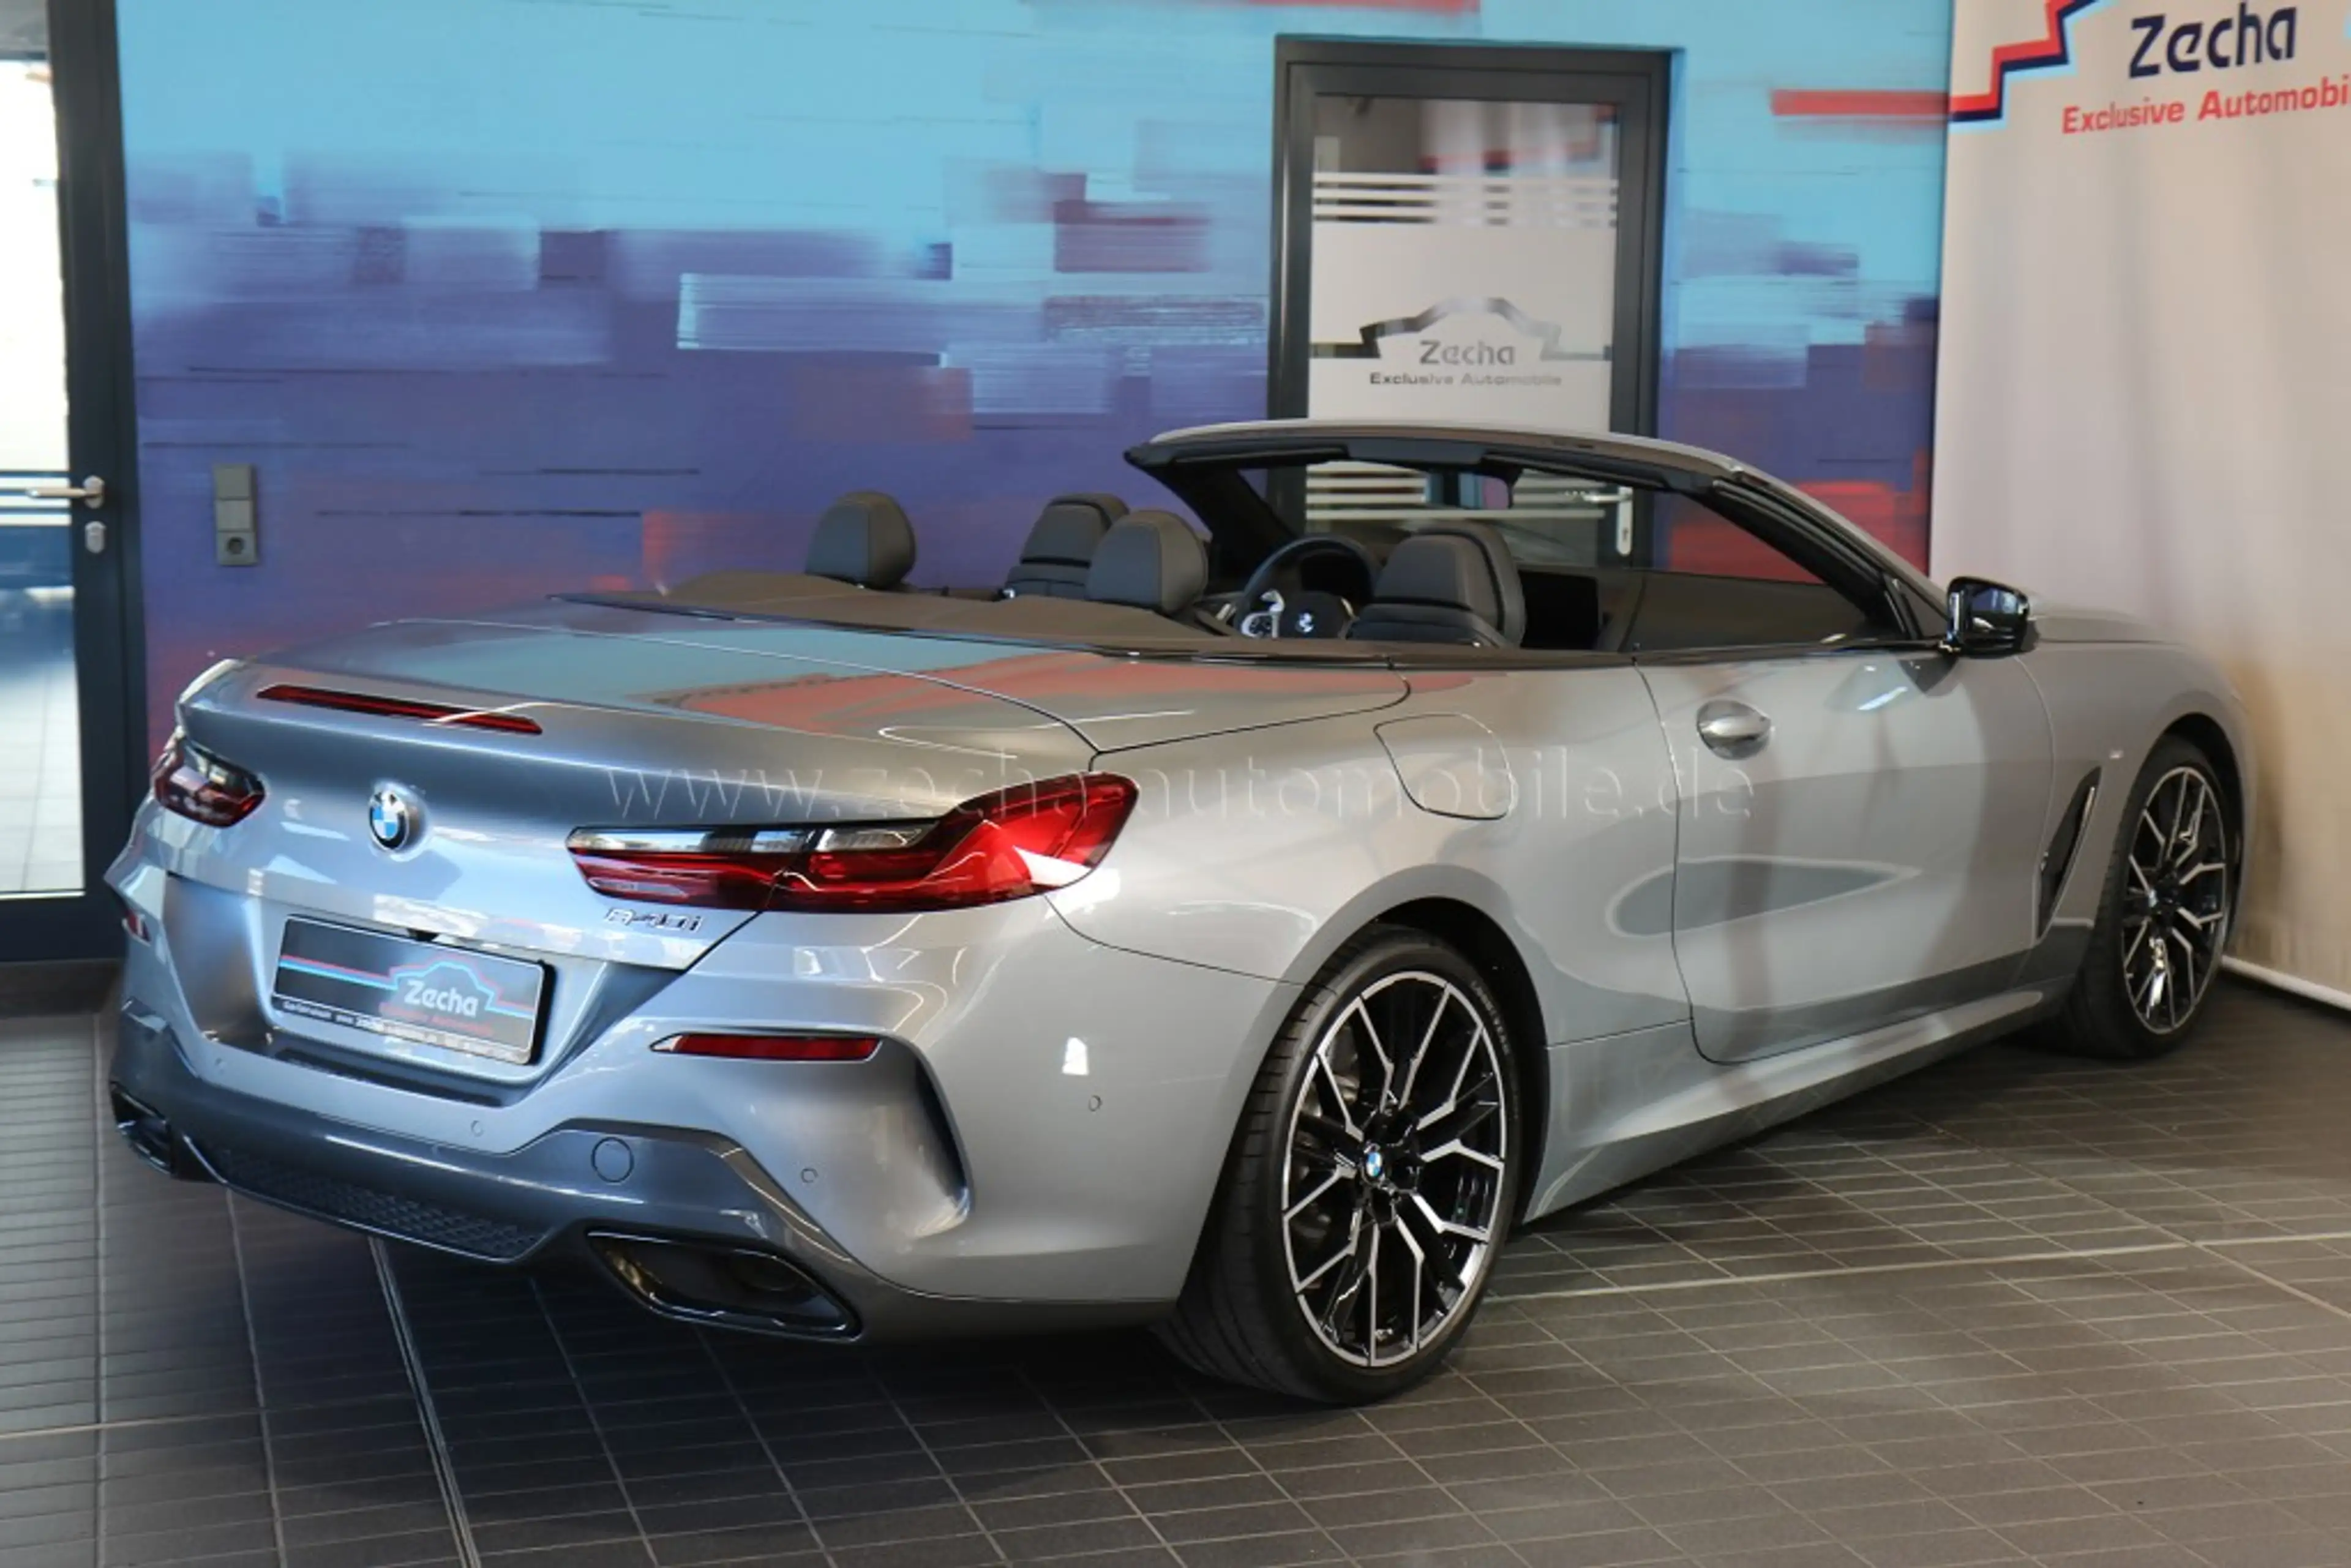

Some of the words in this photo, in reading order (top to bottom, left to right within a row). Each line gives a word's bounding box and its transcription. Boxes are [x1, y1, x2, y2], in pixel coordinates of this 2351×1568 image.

[2129, 2, 2297, 79] Zecha
[2061, 97, 2185, 134] Exclusive
[1419, 339, 1516, 366] Zecha
[1370, 372, 1454, 385] Exclusive
[1461, 372, 1562, 386] Automobile
[404, 980, 479, 1019] Zecha
